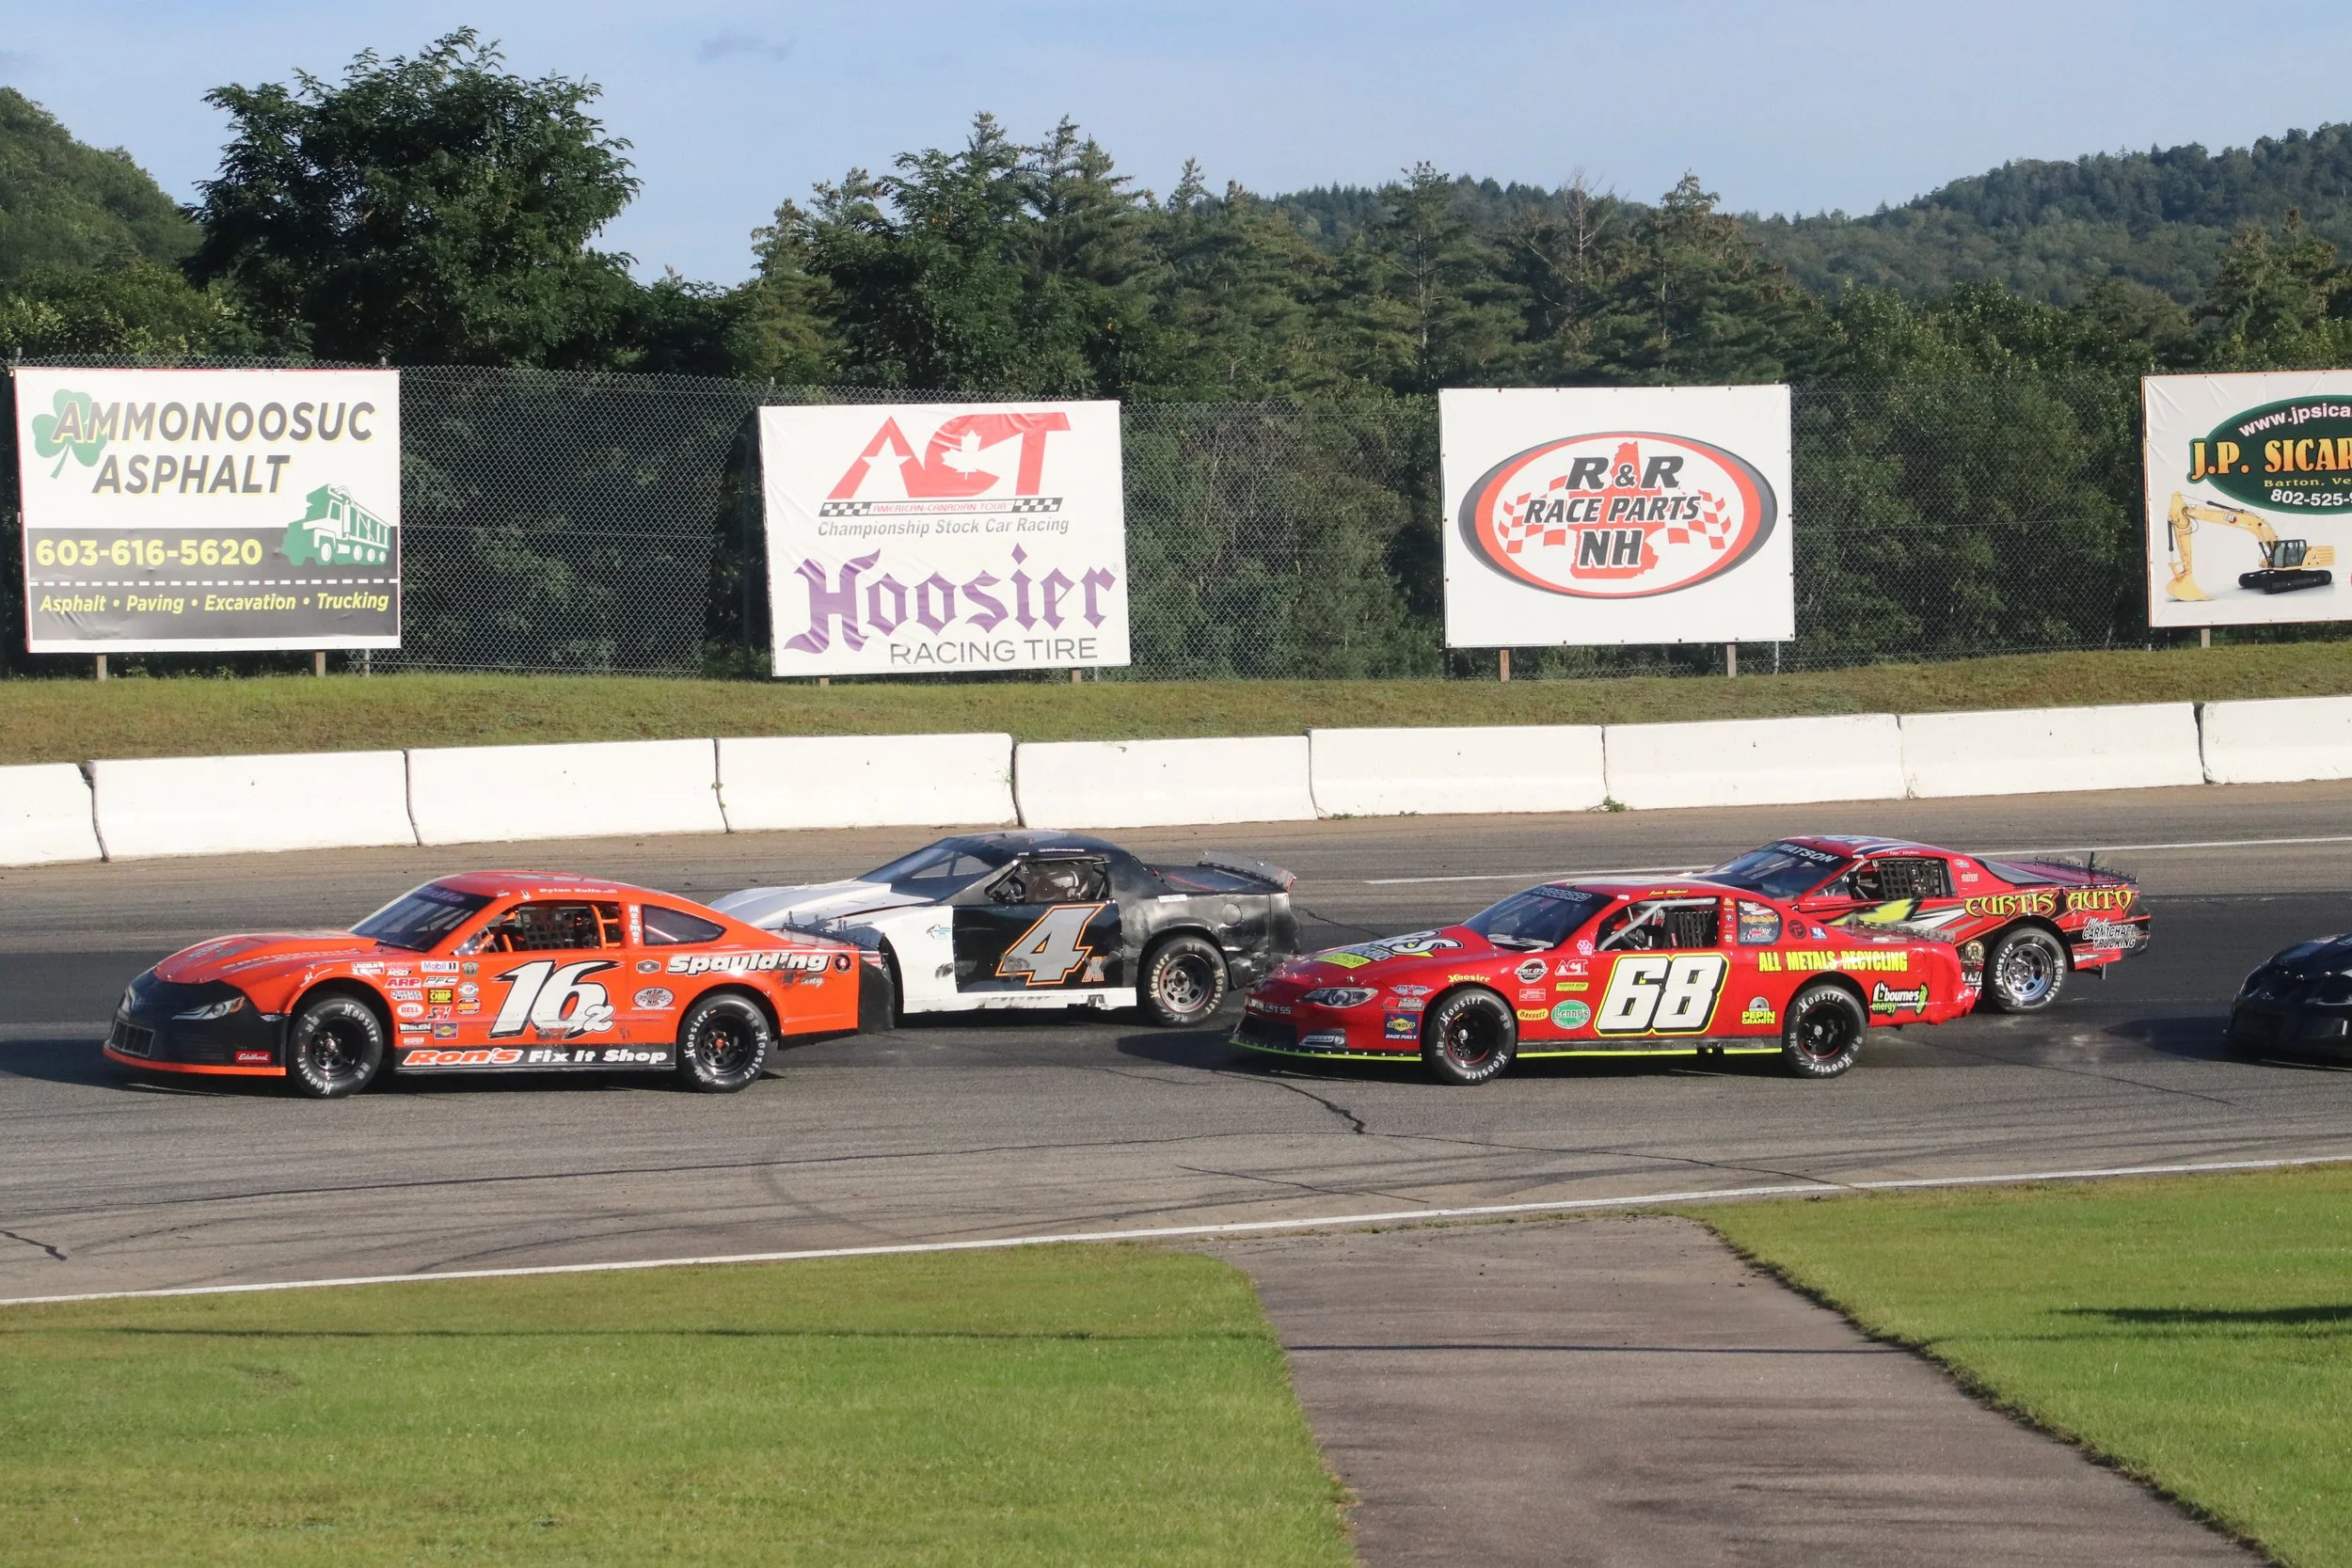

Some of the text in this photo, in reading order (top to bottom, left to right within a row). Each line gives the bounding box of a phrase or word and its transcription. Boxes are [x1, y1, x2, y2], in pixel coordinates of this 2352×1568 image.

[52, 401, 376, 443] AMMONOOSUC
[826, 411, 1071, 499] ACT
[2191, 440, 2250, 481] J.P.
[91, 454, 291, 495] ASPHALT
[1523, 495, 1701, 523] RACE PARTS
[818, 516, 1069, 538] Championship Stock Car Racing
[35, 538, 262, 566] 603-616-5620
[1577, 530, 1642, 567] NH
[40, 592, 389, 614] Asphalt Paving Excavation Trucking
[784, 542, 1117, 654] Hoosier
[890, 637, 1098, 665] RACING TIRE
[1777, 843, 1839, 863] WATSON
[1964, 889, 2137, 918] CURTIS AUTO
[995, 904, 1105, 986] 4
[667, 953, 831, 976] Spaulding
[1758, 950, 1908, 972] ALL METALS RECYCLING
[1994, 942, 2013, 986] Hoosier
[1149, 953, 1169, 999] Hoosier
[1448, 974, 1491, 983] Hoosier
[1594, 952, 1729, 1037] 68
[1798, 992, 1843, 1013] Hoosier
[1871, 1000, 1897, 1014] energy
[1439, 995, 1483, 1026] Hoosier
[1555, 1007, 1588, 1020] Lenny's
[1741, 1010, 1776, 1020] PEPIN
[684, 1010, 708, 1059] Hoosier
[403, 1048, 667, 1066] Ron's Fix It Shop
[744, 1031, 769, 1080] Hoosier
